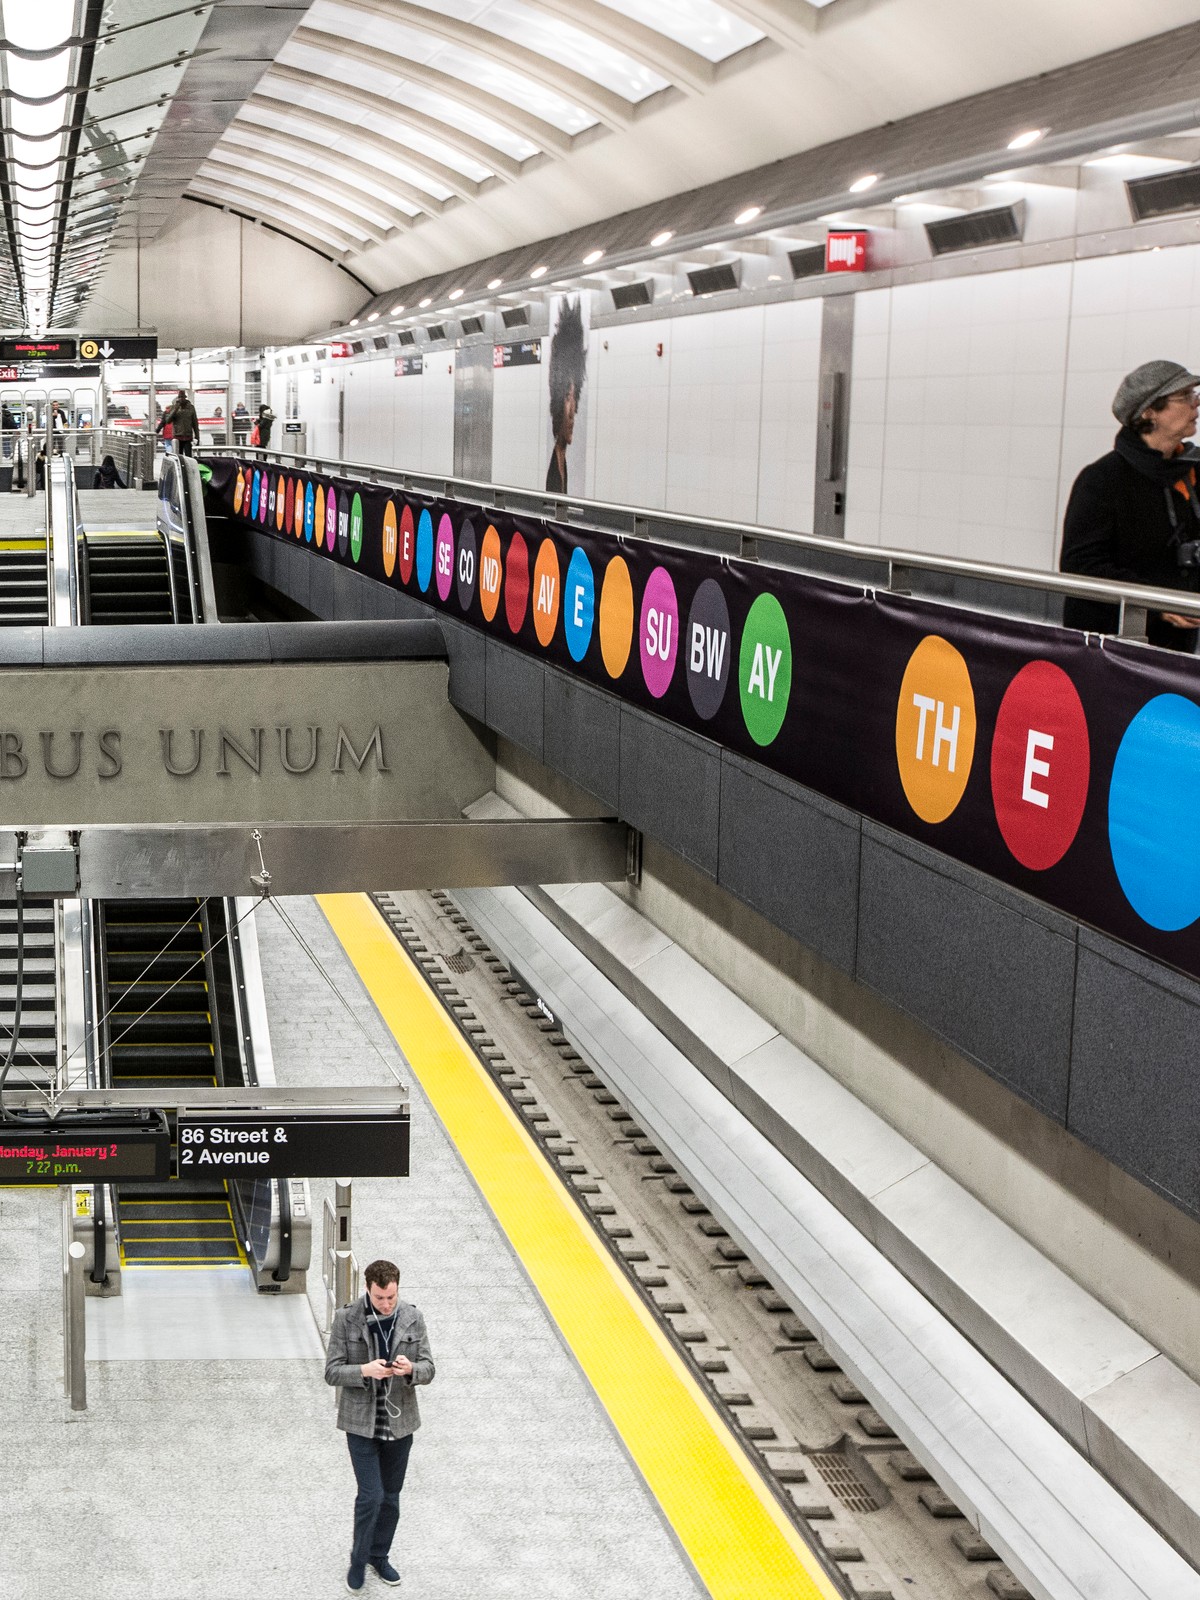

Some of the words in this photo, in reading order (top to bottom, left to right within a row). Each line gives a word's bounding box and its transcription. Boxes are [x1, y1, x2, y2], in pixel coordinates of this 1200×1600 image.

[85, 344, 94, 355] Q
[327, 507, 336, 534] SU
[385, 525, 395, 555] TH
[403, 531, 410, 561] E
[438, 541, 451, 576] SE
[459, 548, 474, 585] CO
[482, 556, 499, 594] ND
[537, 574, 556, 615] AV
[573, 584, 585, 628] E
[645, 607, 672, 661] SU
[690, 622, 727, 681] BW
[747, 642, 783, 702] AY
[158, 725, 393, 776] UNUM
[912, 693, 961, 773] TH
[1021, 728, 1055, 809] E
[181, 1128, 205, 1144] 86
[209, 1128, 269, 1144] Street
[273, 1127, 288, 1143] &
[52, 1145, 108, 1160] January
[110, 1144, 118, 1157] 2
[181, 1149, 194, 1164] 2
[198, 1149, 270, 1164] Avenue
[54, 1162, 82, 1176] p.m.
